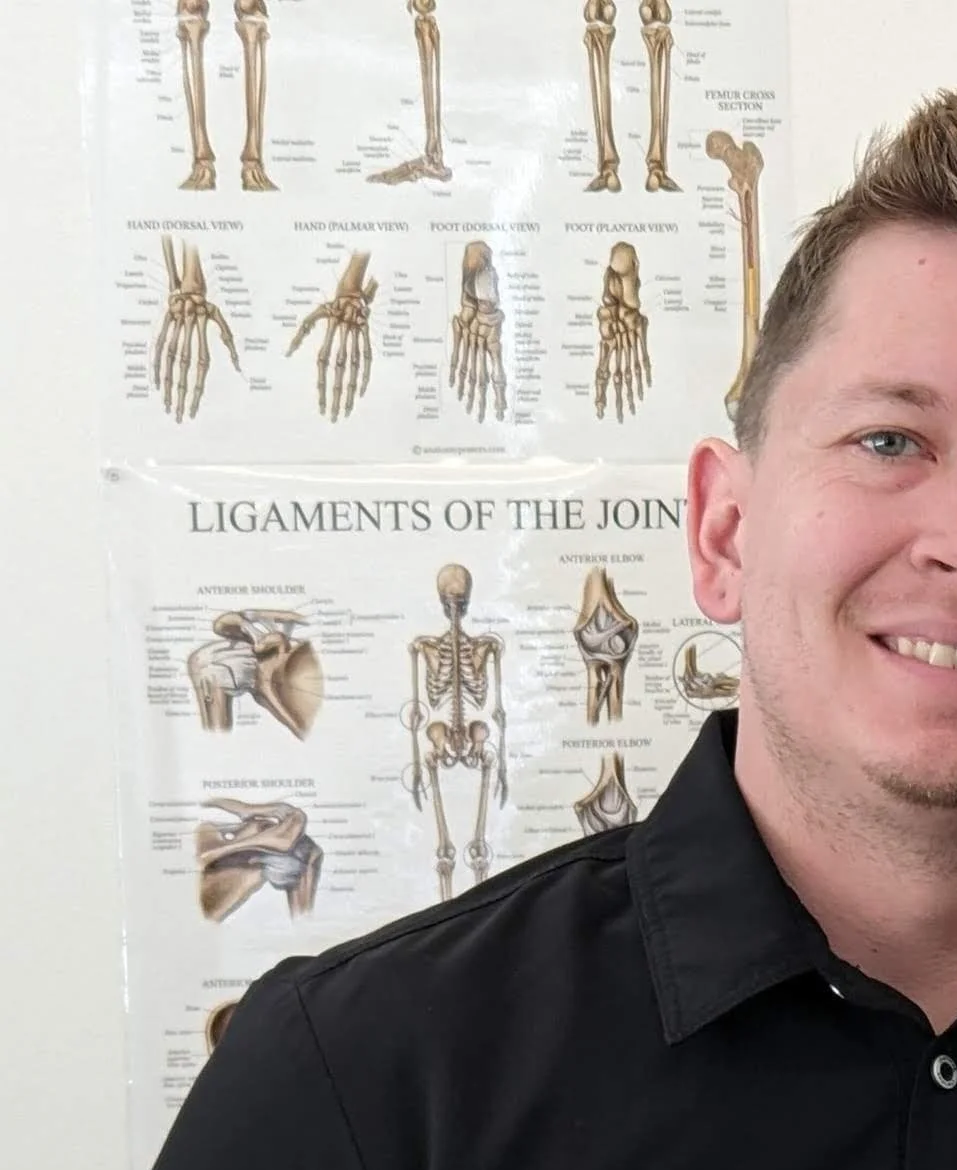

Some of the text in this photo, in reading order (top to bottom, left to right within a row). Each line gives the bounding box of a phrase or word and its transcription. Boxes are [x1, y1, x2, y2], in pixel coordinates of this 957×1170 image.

[705, 90, 776, 101] FEMUR CROSS
[718, 101, 763, 112] SECTION
[127, 219, 244, 231] HAND (DORSAL VIEW)
[294, 221, 409, 232] HAND (PALMAR VIEW)
[430, 222, 541, 233] FOOT (DORSAL VIEW)
[565, 222, 679, 233] FOOT (PLANTAR VIEW)
[188, 498, 688, 533] LIGAMENTS OF THE JOIN
[559, 552, 645, 564] ANTERIOR ELBOW
[197, 584, 306, 595] ANTERIOR SHOULDER
[562, 738, 653, 749] POSTERIOR ELBOW
[202, 778, 316, 789] POSTERIOR SHOULDER
